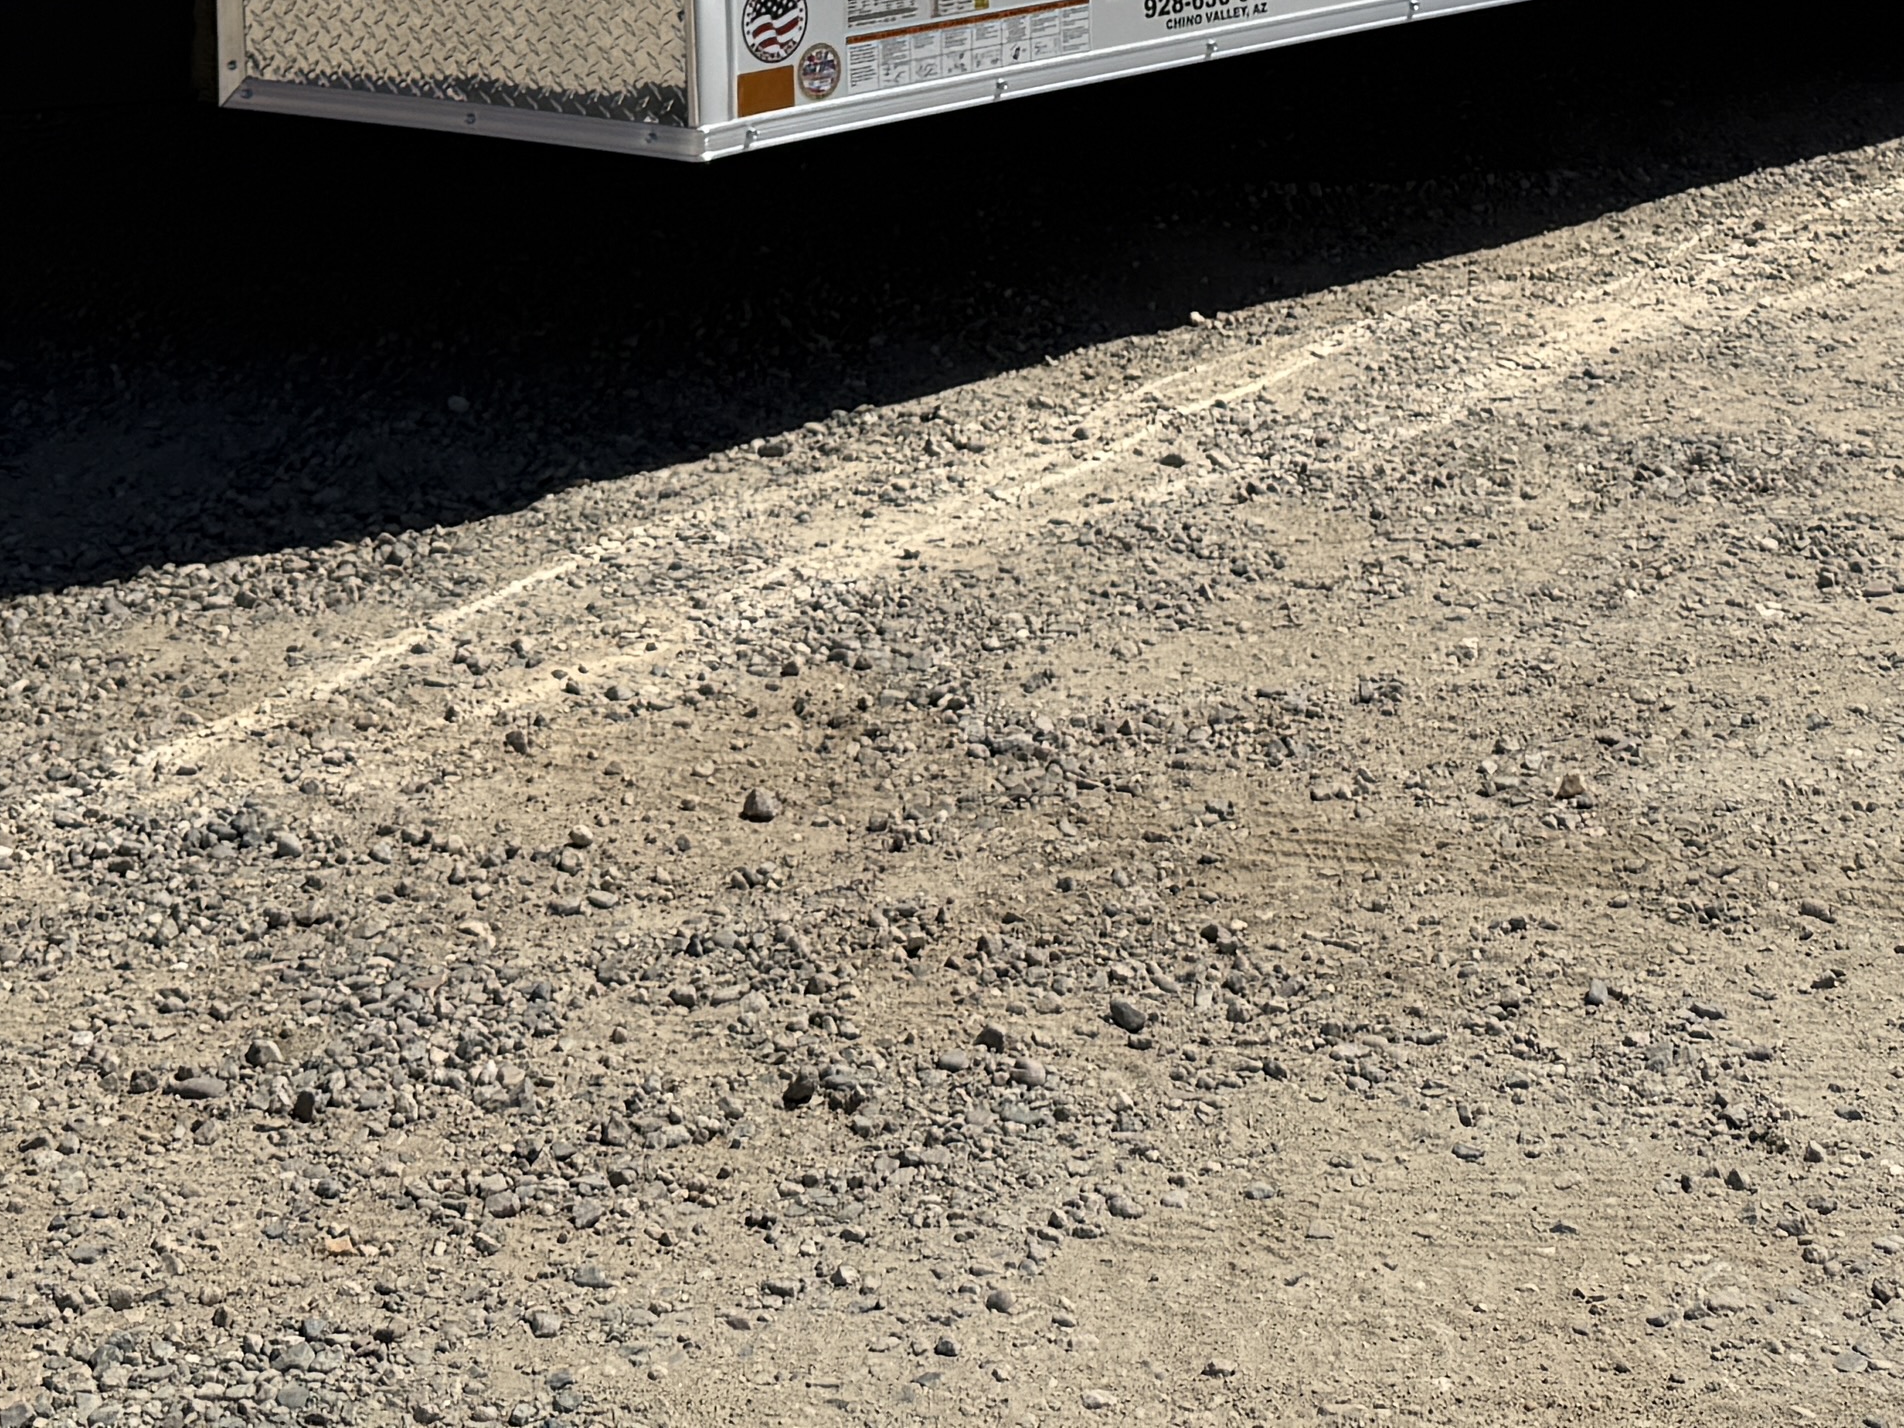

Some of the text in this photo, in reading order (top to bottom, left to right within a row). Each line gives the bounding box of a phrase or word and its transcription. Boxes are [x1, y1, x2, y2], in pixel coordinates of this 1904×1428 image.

[1166, 2, 1268, 30] CHINO VALLEY, AZ
